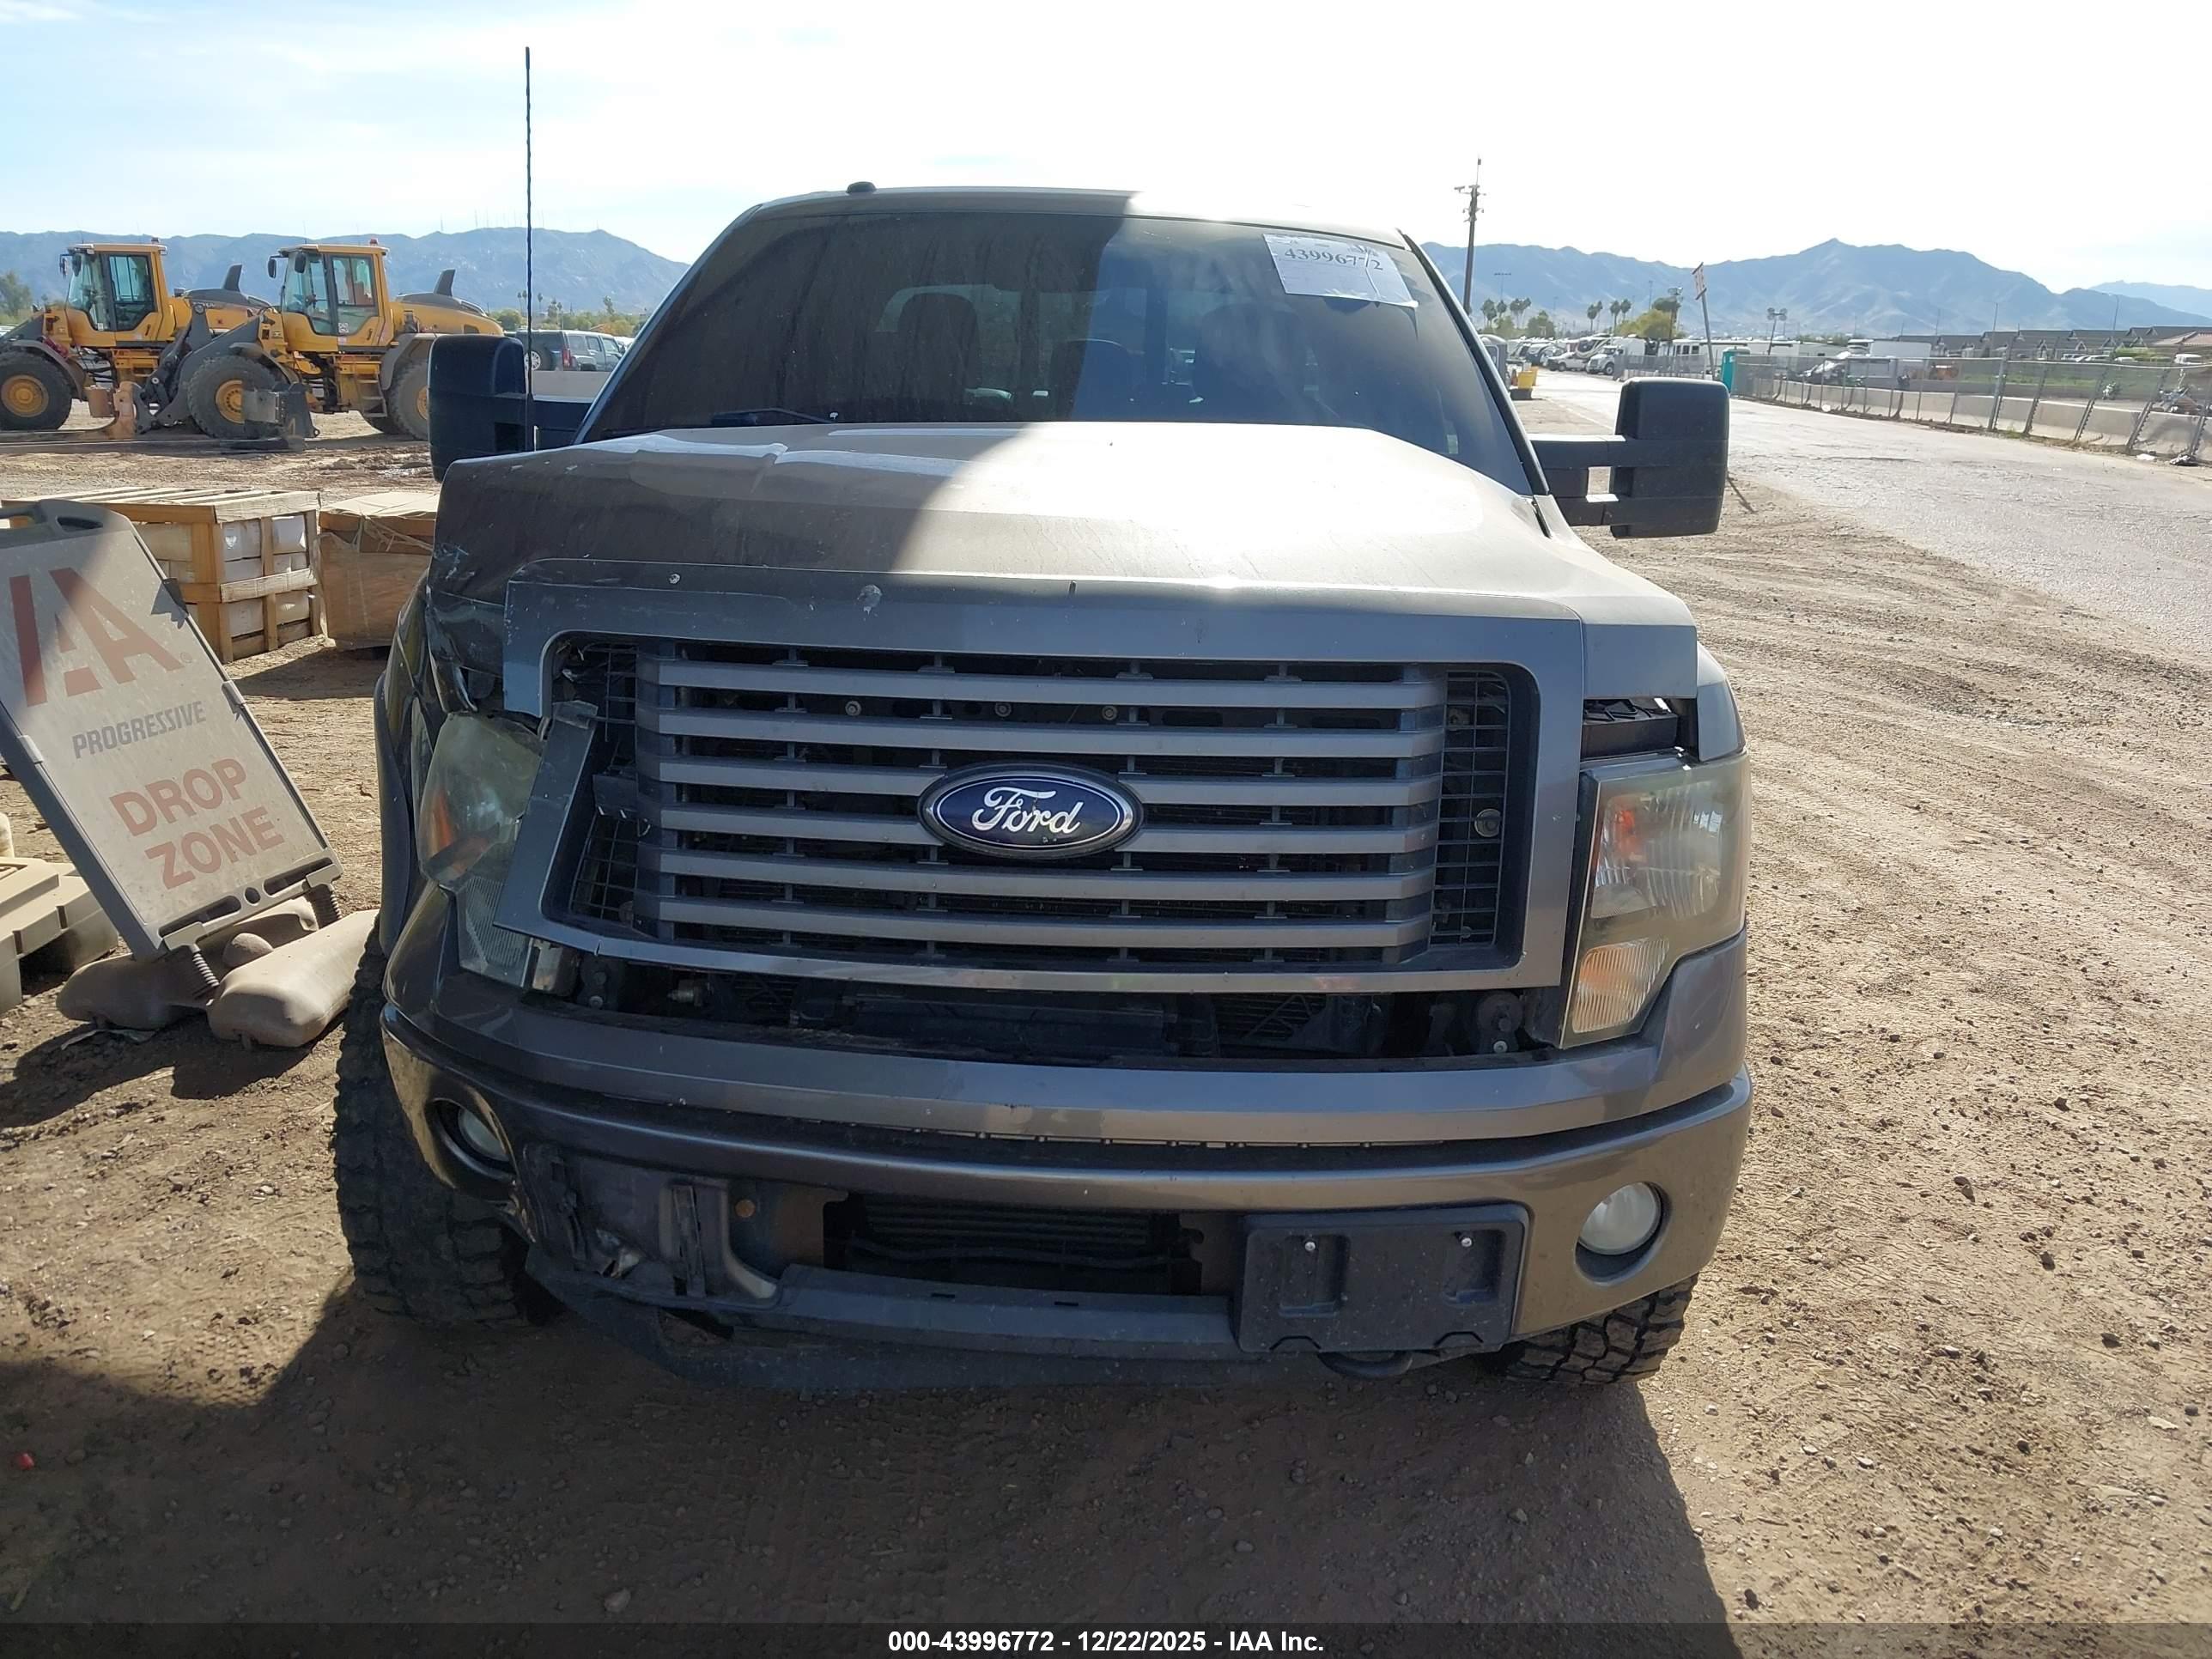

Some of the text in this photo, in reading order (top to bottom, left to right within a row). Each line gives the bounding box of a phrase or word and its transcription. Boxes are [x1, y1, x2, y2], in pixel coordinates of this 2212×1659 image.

[1285, 248, 1383, 270] 43996772
[72, 700, 207, 759] PROGRESSIVE
[109, 757, 248, 837] DROP
[971, 787, 1084, 834] Ford
[143, 805, 285, 890] ZONE
